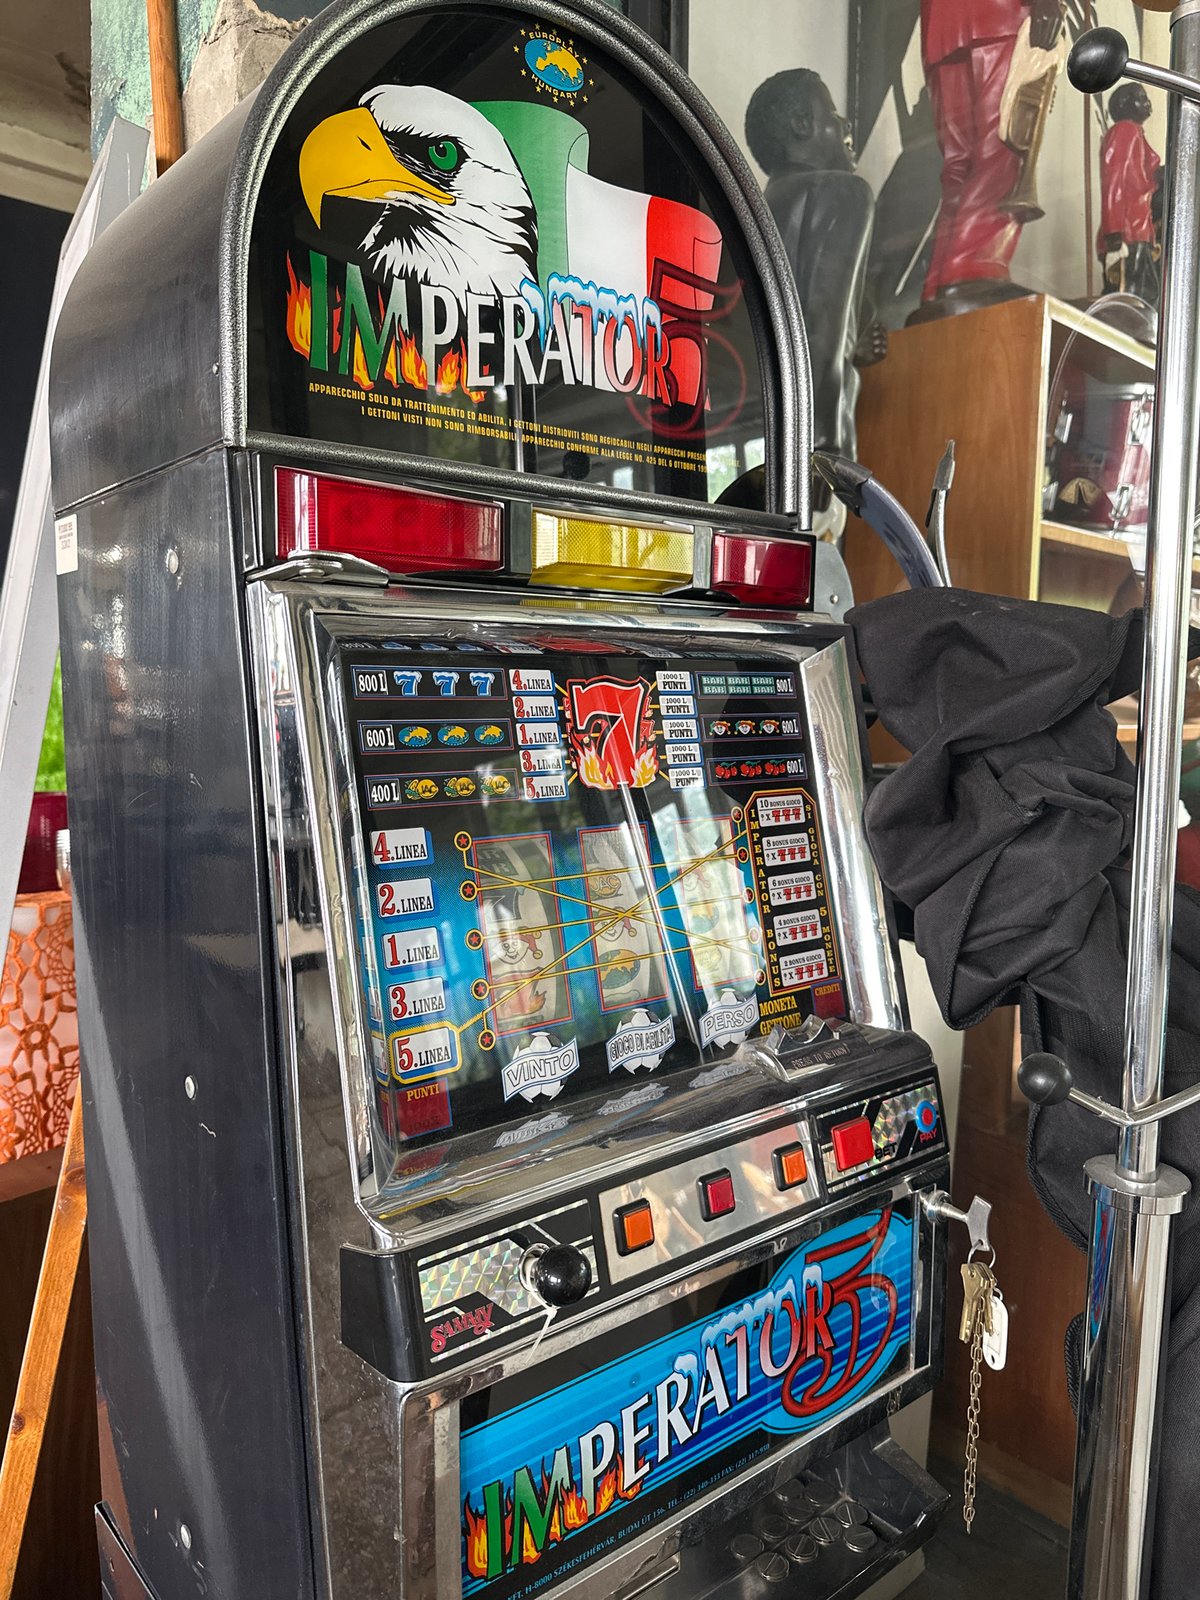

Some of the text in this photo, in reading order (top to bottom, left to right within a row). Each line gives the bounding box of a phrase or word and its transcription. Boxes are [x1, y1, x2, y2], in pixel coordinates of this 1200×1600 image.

[529, 32, 579, 58] EUROPLAY
[532, 74, 577, 98] HUNGARY
[309, 250, 672, 407] IMPERATOR
[309, 383, 365, 400] APPARECCHIO
[369, 393, 388, 404] SOLO
[392, 397, 402, 407] DA
[404, 399, 464, 418] TRATTENIMENTO
[478, 413, 506, 426] ABILITA.
[514, 420, 540, 432] GETTONI
[582, 432, 598, 442] SONO
[600, 436, 635, 448] REGIOCABILI
[637, 442, 652, 452] NEGLI
[654, 445, 686, 458] APPARECCHI
[362, 406, 364, 415] I
[368, 408, 400, 421] GETTONI
[403, 413, 422, 424] VISTI
[426, 417, 441, 428] NON
[445, 421, 464, 432] SONO
[522, 434, 564, 450] APPARECCHIO
[567, 442, 599, 455] CONFORME
[601, 448, 614, 457] ALLA
[616, 451, 632, 460] LEGGE
[635, 454, 644, 462] NO.
[646, 456, 656, 464] 425
[658, 458, 667, 466] DEL
[674, 461, 696, 471] OTTOBRE
[663, 681, 687, 689] PUNTI
[702, 676, 724, 684] BAR
[752, 677, 774, 685] BAR
[704, 686, 775, 694] BAR BAR BAR
[666, 705, 690, 714] PUNTI
[669, 729, 693, 738] PUNTI
[672, 753, 696, 762] PUNTI
[760, 799, 769, 808] 10
[750, 809, 770, 913] IMPERATOR
[820, 907, 827, 916] 5
[766, 929, 781, 987] BONUS
[789, 958, 806, 966] BONUS
[806, 954, 821, 962] GIOCO
[822, 926, 836, 973] MONETE
[815, 983, 840, 996] CREDITI
[759, 996, 797, 1016] MONETA
[704, 1004, 755, 1038] PERSO
[610, 1034, 635, 1061] GIOCO
[635, 1033, 644, 1051] DI
[506, 1053, 574, 1087] VINTO
[406, 1083, 440, 1101] PUNTI
[920, 1128, 937, 1143] PAY
[875, 1142, 897, 1158] BET
[430, 1302, 495, 1353] SAMMY
[482, 1262, 836, 1580] IMPERATOR
[526, 1573, 552, 1594] H-8000
[618, 1521, 640, 1539] BUDAI
[642, 1513, 651, 1524] ÚT
[722, 1466, 734, 1477] FAX:
